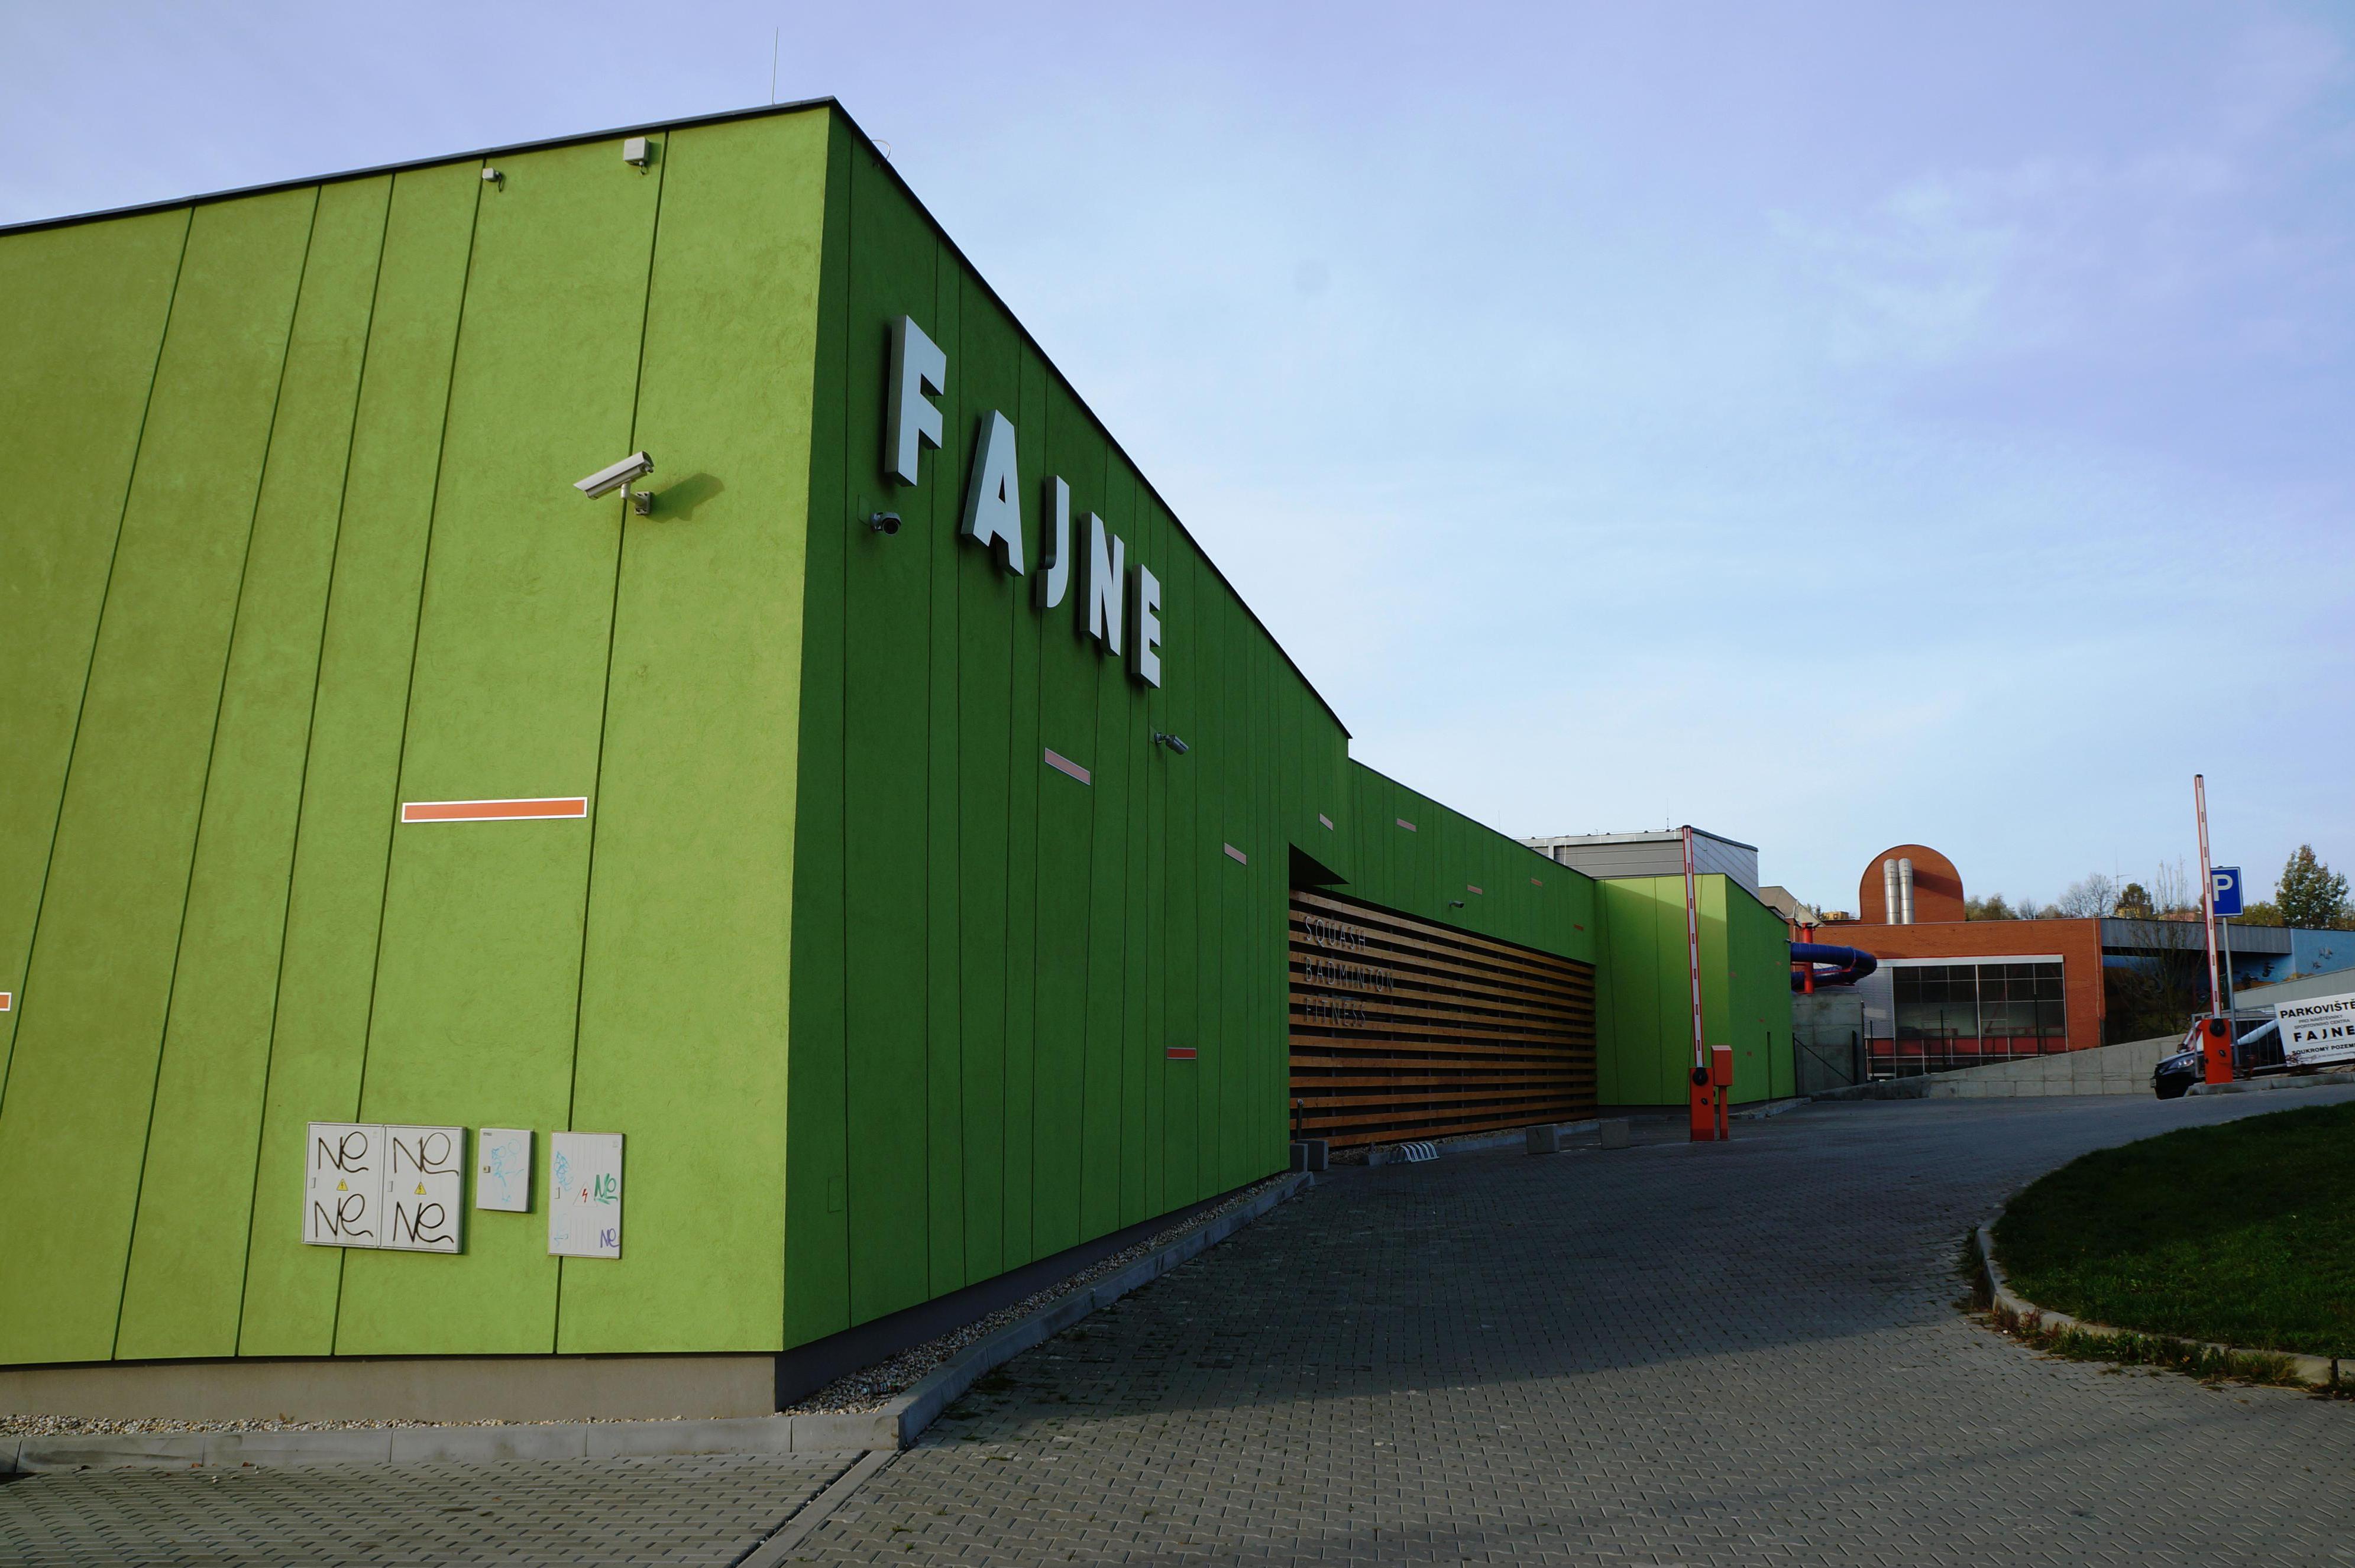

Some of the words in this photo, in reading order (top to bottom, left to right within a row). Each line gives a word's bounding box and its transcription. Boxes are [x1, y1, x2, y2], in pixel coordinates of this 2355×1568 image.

[885, 315, 1160, 688] FAJNE
[2212, 874, 2233, 901] P
[1305, 916, 1366, 951] SQUASH
[1305, 957, 1394, 993] BADMINTON
[1305, 997, 1366, 1027] FITNESS
[2280, 999, 2355, 1018] PARKOVIŠTĚ
[2293, 1025, 2355, 1042] FAJNE
[2292, 1045, 2330, 1055] SOUKROMÝ
[2331, 1042, 2355, 1051] POZEM
